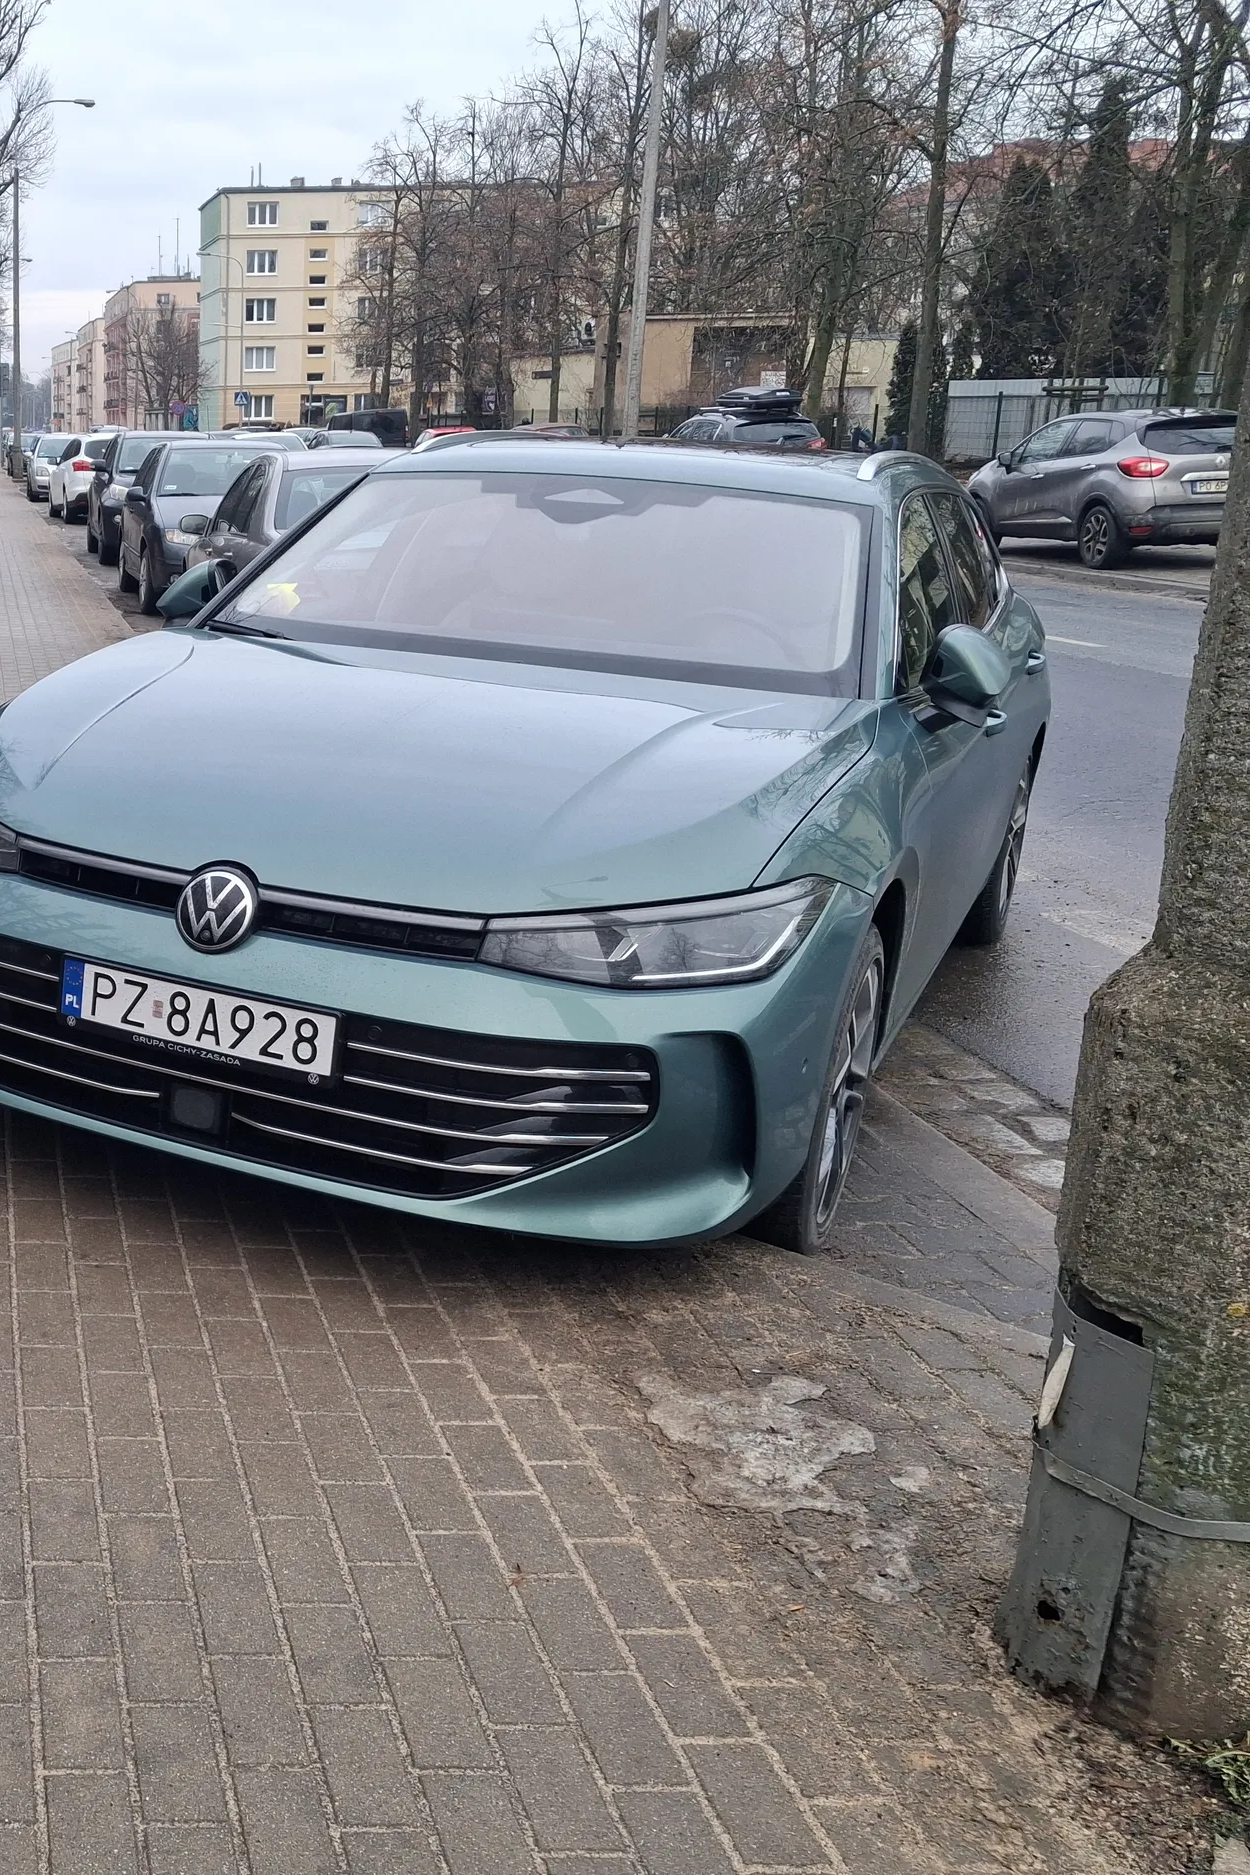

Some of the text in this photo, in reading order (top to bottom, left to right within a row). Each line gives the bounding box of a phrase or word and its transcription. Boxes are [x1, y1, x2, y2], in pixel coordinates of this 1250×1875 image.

[181, 872, 251, 946] VW
[65, 993, 80, 1009] PL
[90, 971, 319, 1065] PZ 8A928
[132, 1034, 241, 1067] GRUPA CICHY-ZASADA
